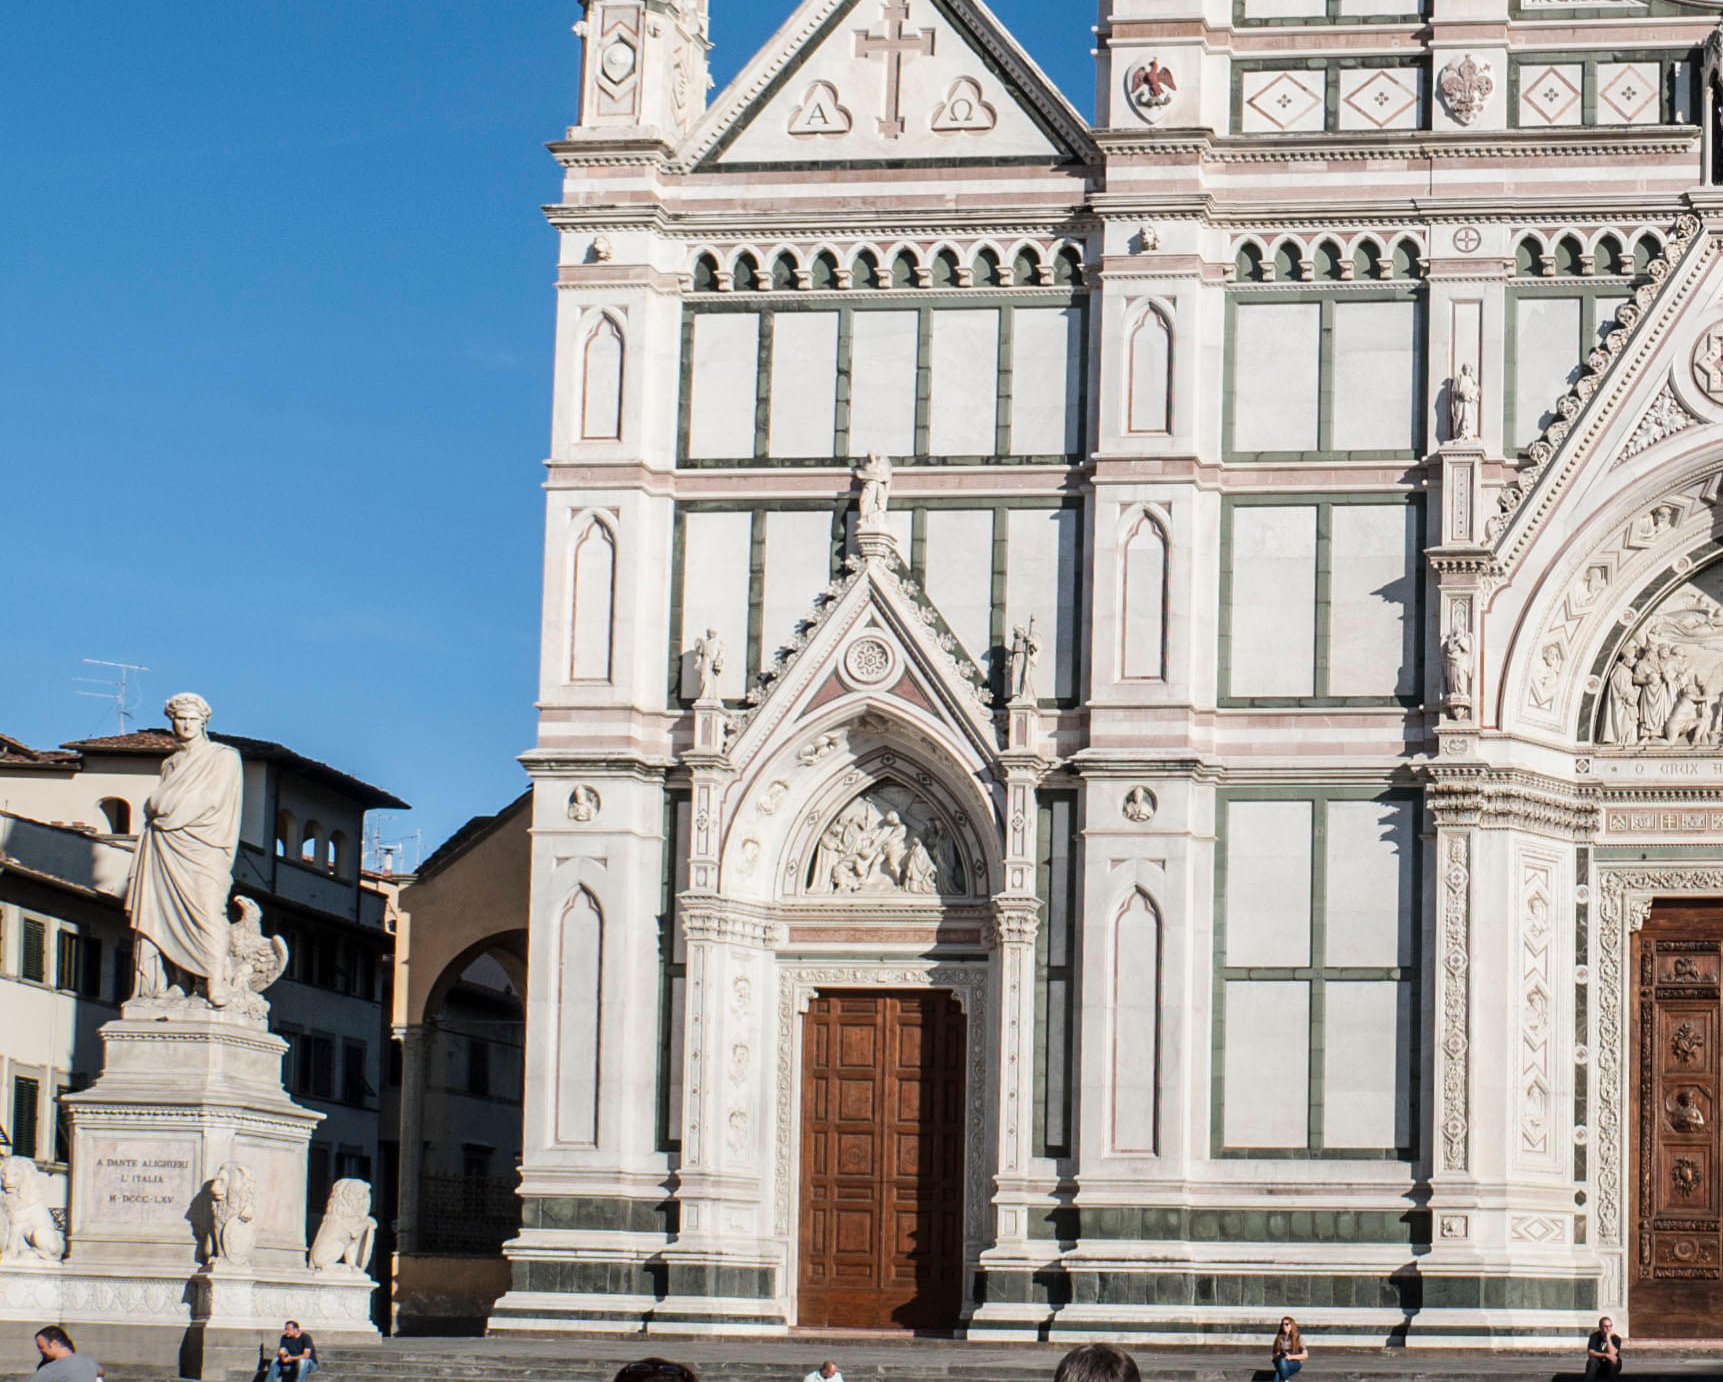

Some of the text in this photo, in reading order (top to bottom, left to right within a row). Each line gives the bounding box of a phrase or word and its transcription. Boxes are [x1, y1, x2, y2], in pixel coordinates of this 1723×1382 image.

[949, 98, 974, 122] Ω
[1635, 763, 1645, 774] O
[96, 1159, 190, 1169] A DANTE ALIGHIERI
[132, 1174, 164, 1184] ITALIA
